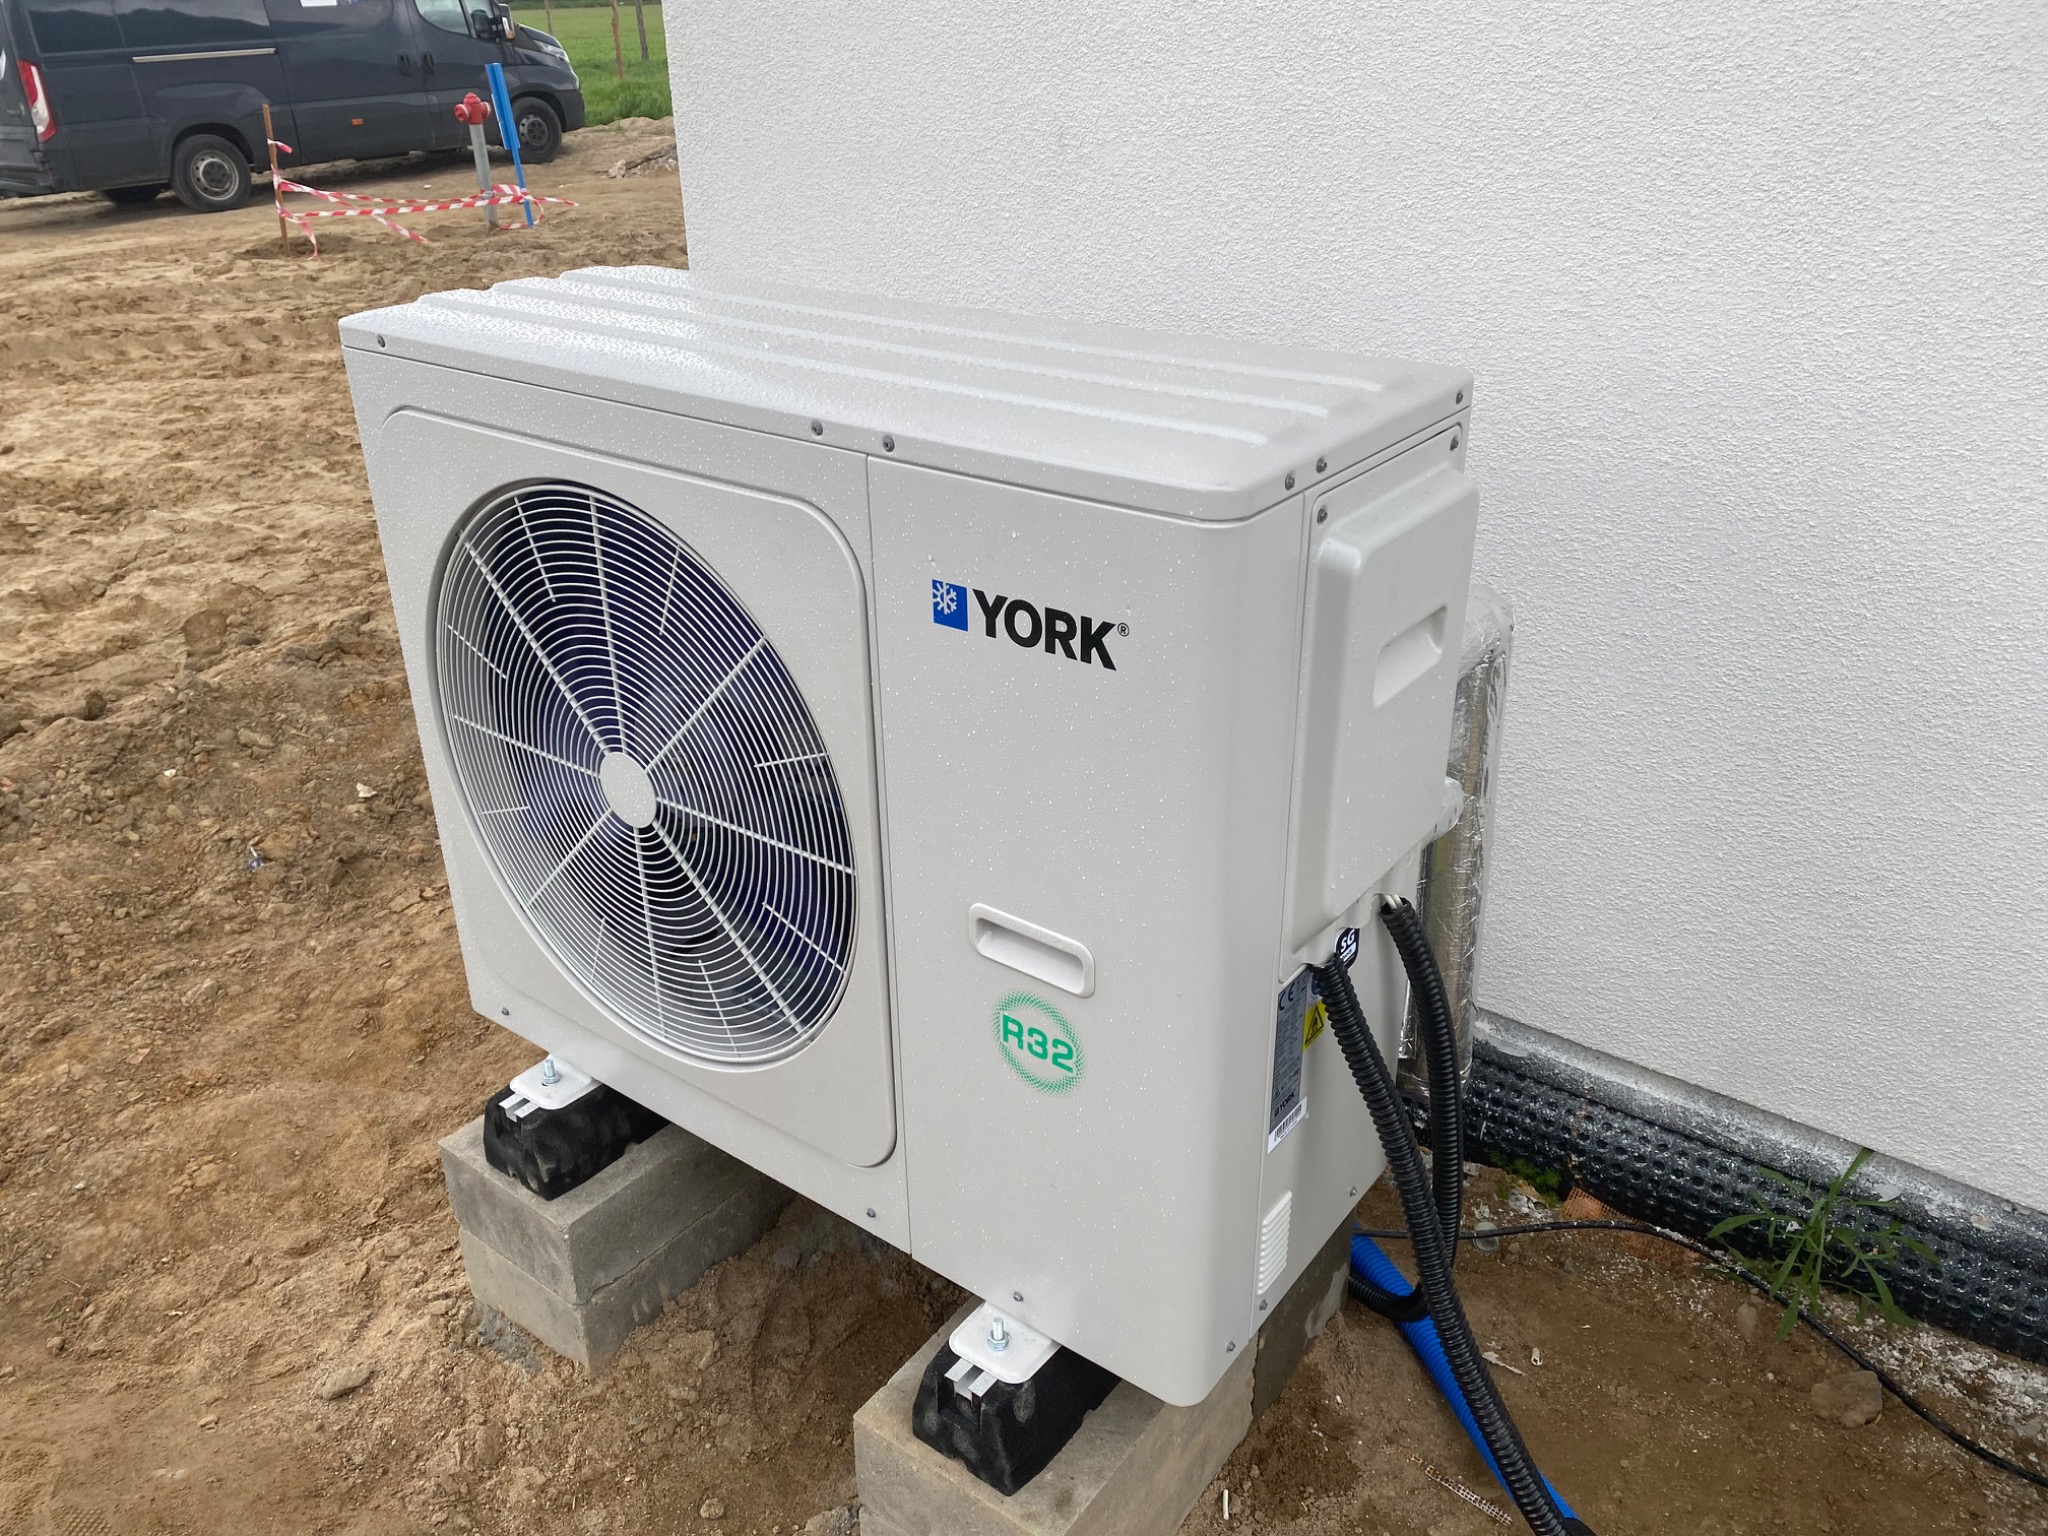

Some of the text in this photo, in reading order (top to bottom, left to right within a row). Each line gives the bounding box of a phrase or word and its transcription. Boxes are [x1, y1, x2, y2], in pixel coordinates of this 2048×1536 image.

[1340, 929, 1355, 953] SG
[1002, 1014, 1074, 1074] R32
[1279, 1091, 1296, 1112] YORK
